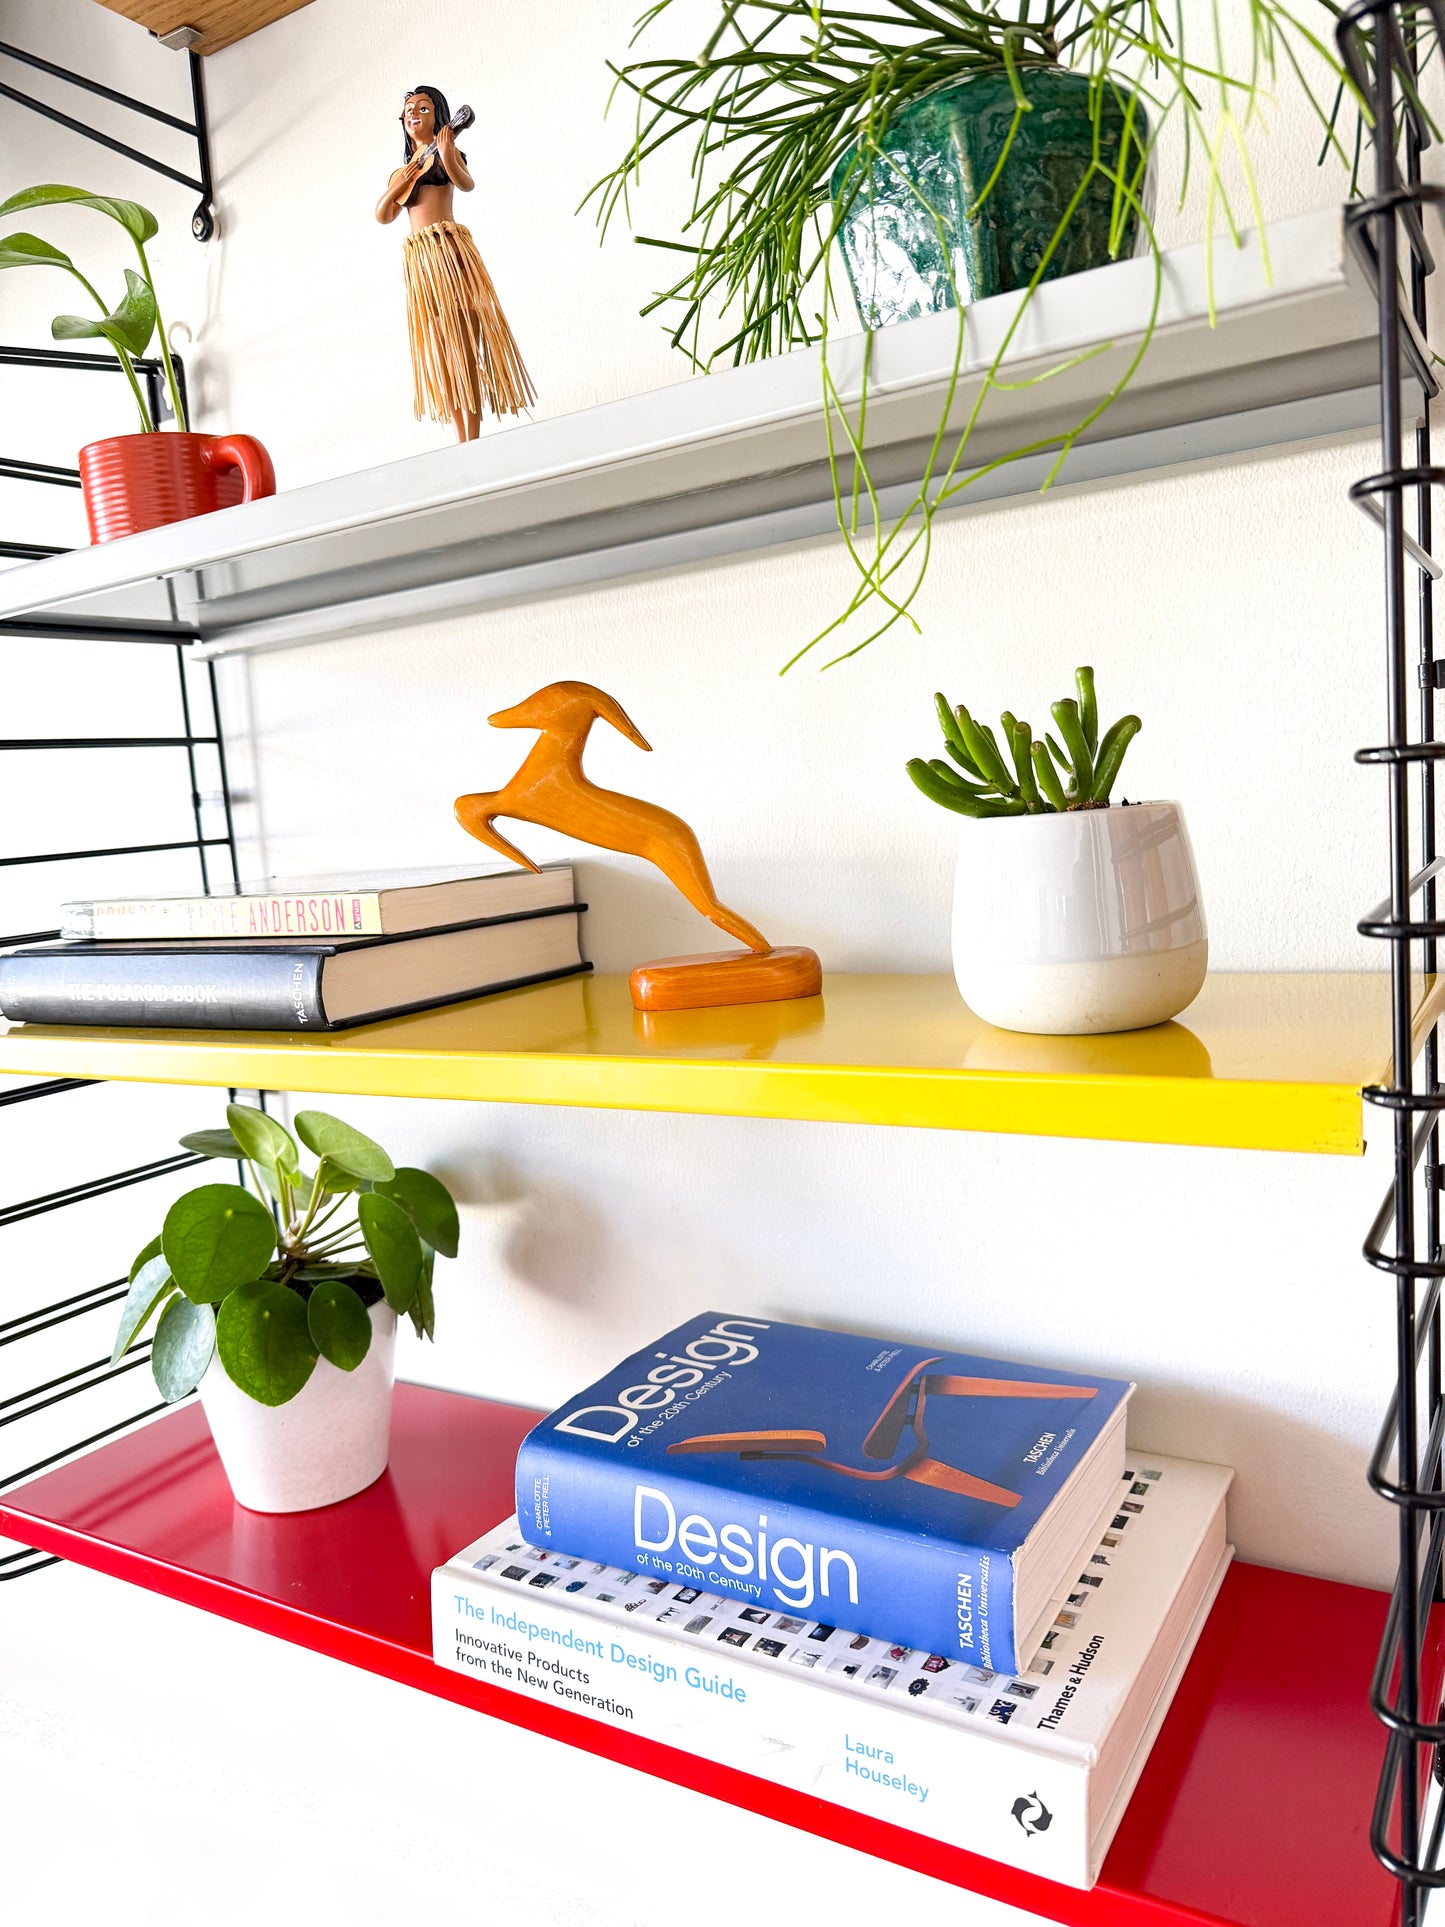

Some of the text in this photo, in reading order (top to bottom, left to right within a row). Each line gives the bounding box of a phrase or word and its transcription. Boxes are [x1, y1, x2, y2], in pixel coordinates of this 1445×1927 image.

[249, 898, 346, 934] ANDERSON
[352, 899, 362, 930] Aurum
[67, 983, 218, 1003] THE POLAROID BOOK
[292, 963, 309, 1024] TASCHEN
[553, 1318, 771, 1444] Design
[627, 1370, 732, 1447] of the 20th Century
[1022, 1431, 1057, 1463] TASCHEN
[534, 1477, 543, 1530] CHARLOTTE
[542, 1500, 551, 1529] PETER
[545, 1529, 552, 1537] &
[634, 1484, 859, 1609] Design
[636, 1552, 762, 1598] of the 20th Century
[957, 1573, 975, 1650] TASCHEN
[977, 1555, 994, 1671] Bibliotheca Universalis
[453, 1594, 748, 1703] The Independent Design Guide
[455, 1628, 591, 1684] Innovative Products
[455, 1647, 634, 1720] from the New Generation
[1037, 1634, 1105, 1730] Thames & Hudson
[844, 1733, 895, 1765] Laura
[845, 1757, 930, 1803] Houseley
